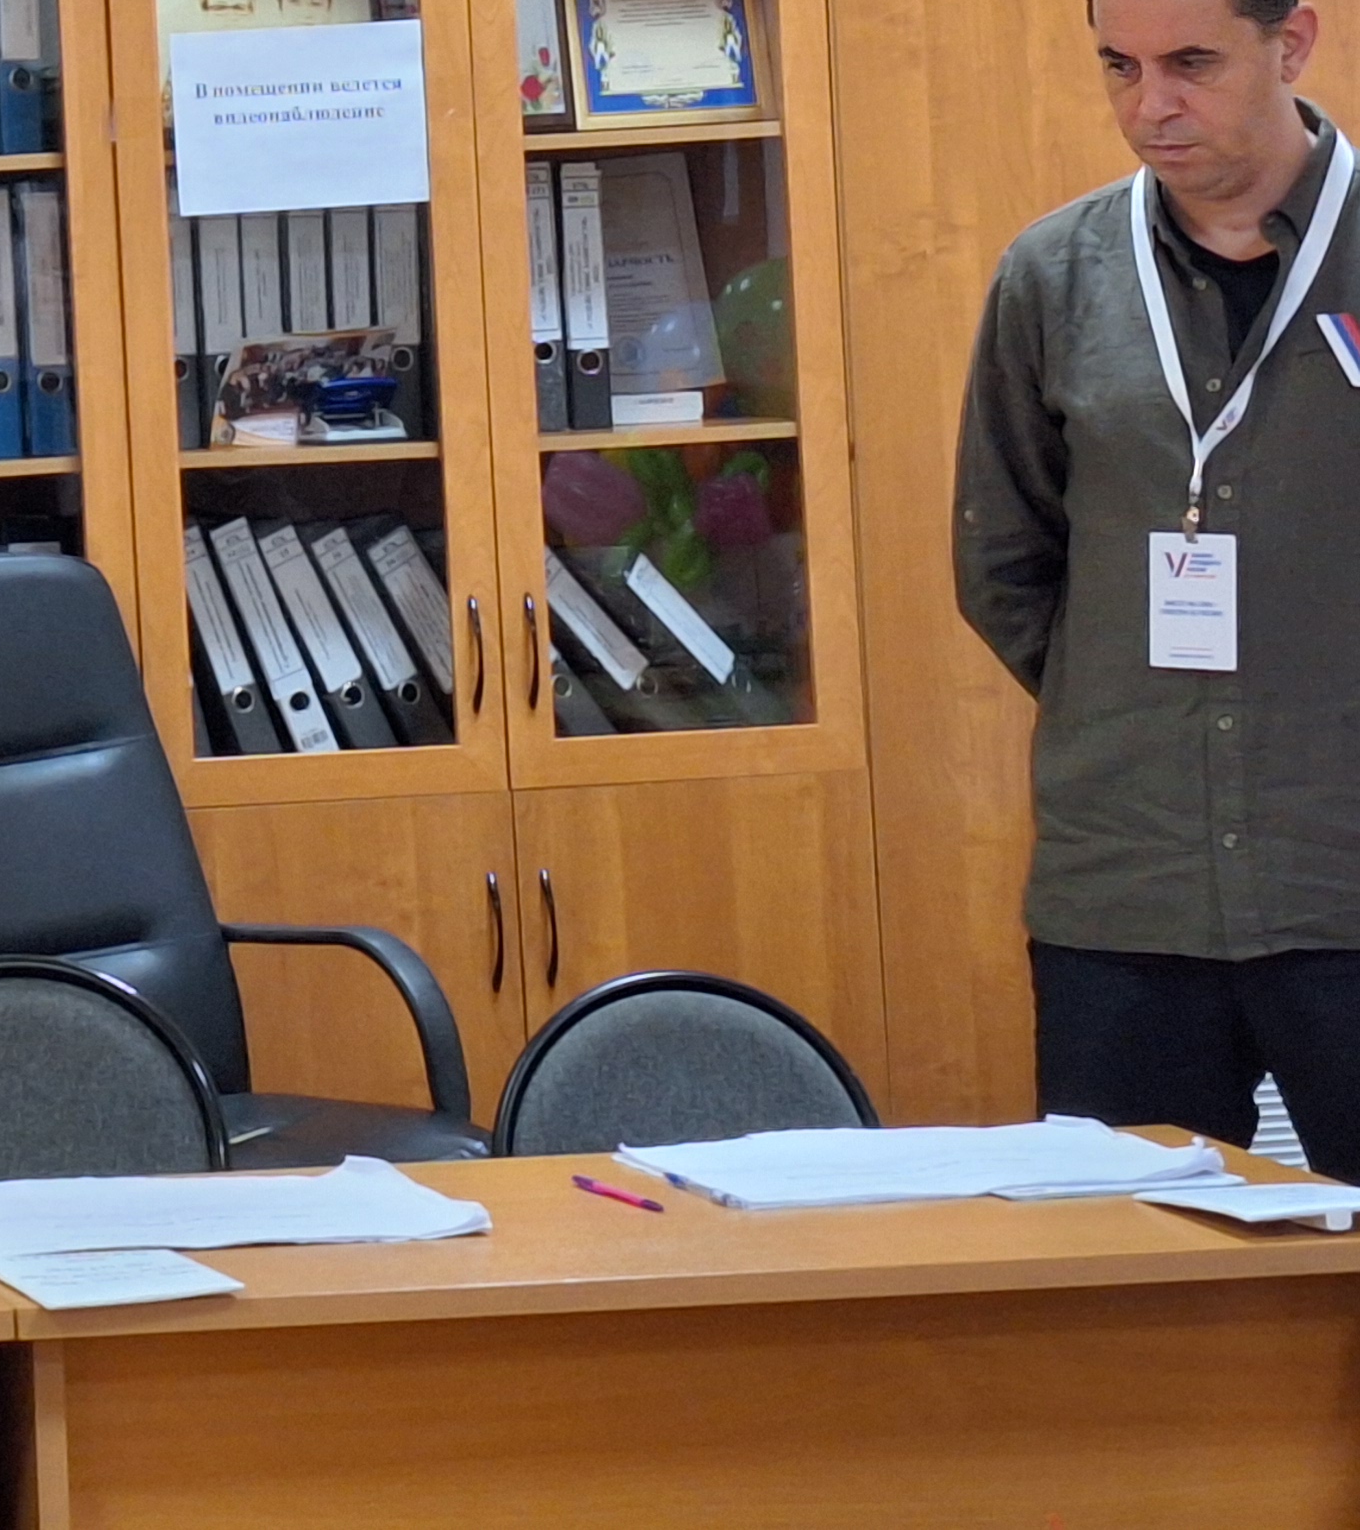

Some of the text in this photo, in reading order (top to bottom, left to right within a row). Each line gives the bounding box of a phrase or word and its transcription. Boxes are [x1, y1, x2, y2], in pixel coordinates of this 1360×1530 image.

[196, 78, 403, 99] В помещении ведется
[214, 106, 385, 126] видеонаблюдение
